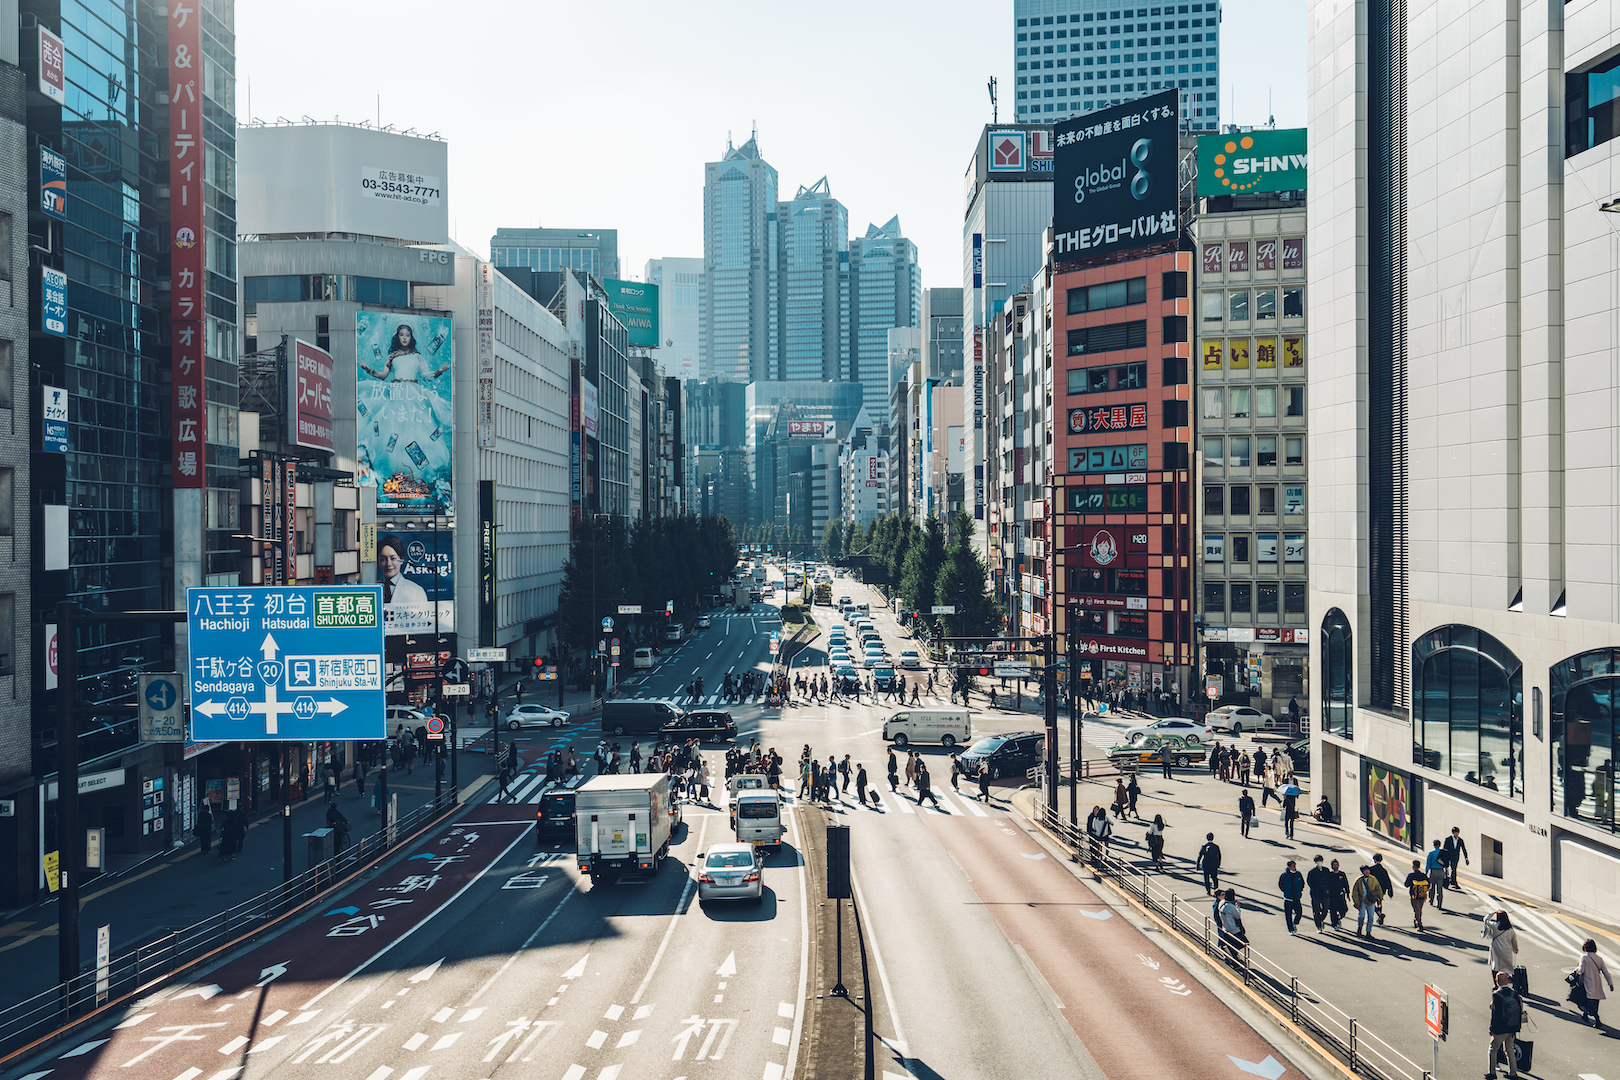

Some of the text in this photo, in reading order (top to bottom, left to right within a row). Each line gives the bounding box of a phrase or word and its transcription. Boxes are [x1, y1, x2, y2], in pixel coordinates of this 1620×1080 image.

[43, 39, 62, 72] 茜会
[1056, 105, 1175, 147] 未来の不動産を面白くする。
[1233, 154, 1308, 174] SHINW
[379, 170, 424, 184] 広告募集中
[1075, 158, 1126, 203] global
[362, 178, 440, 198] 03-3543-7771
[374, 191, 428, 205] www.hit-ad.co.jp
[1055, 210, 1176, 254] THEグローバル社
[420, 251, 448, 265] FPG
[45, 271, 64, 290] AEON
[46, 288, 64, 305] 英会話
[43, 302, 66, 318] イーオン
[627, 317, 652, 329] MIWA
[1204, 344, 1276, 365] 占い館
[177, 267, 197, 476] カラオケ歌広場
[299, 354, 318, 374] SUPER
[370, 380, 440, 402] 放置しよう
[974, 365, 982, 406] SHINJUKU
[46, 406, 66, 419] テイケイ
[382, 405, 433, 424] いまだ!
[1094, 405, 1147, 430] 大黒屋
[791, 422, 822, 432] やまや
[1072, 413, 1084, 429] 質
[1073, 450, 1124, 469] アコム
[1133, 447, 1144, 457] 6F
[1128, 474, 1145, 482] アコム
[194, 593, 307, 616] 八王子 初台
[317, 596, 373, 615] 首都高
[200, 617, 310, 632] Hachioji Hatsudai
[316, 614, 375, 626] SHUTOKO EXP
[1100, 644, 1146, 655] First Kitchen
[195, 656, 253, 678] 千駄ヶ谷
[263, 665, 278, 678] 20
[318, 659, 377, 676] 新宿駅西口
[194, 680, 255, 694] Sendagaya
[319, 677, 352, 689] Shinjuku
[228, 702, 246, 714] 414
[296, 702, 314, 713] 414
[148, 716, 175, 726] 7-20
[143, 726, 181, 736] この先50m
[87, 777, 107, 786] SELECT
